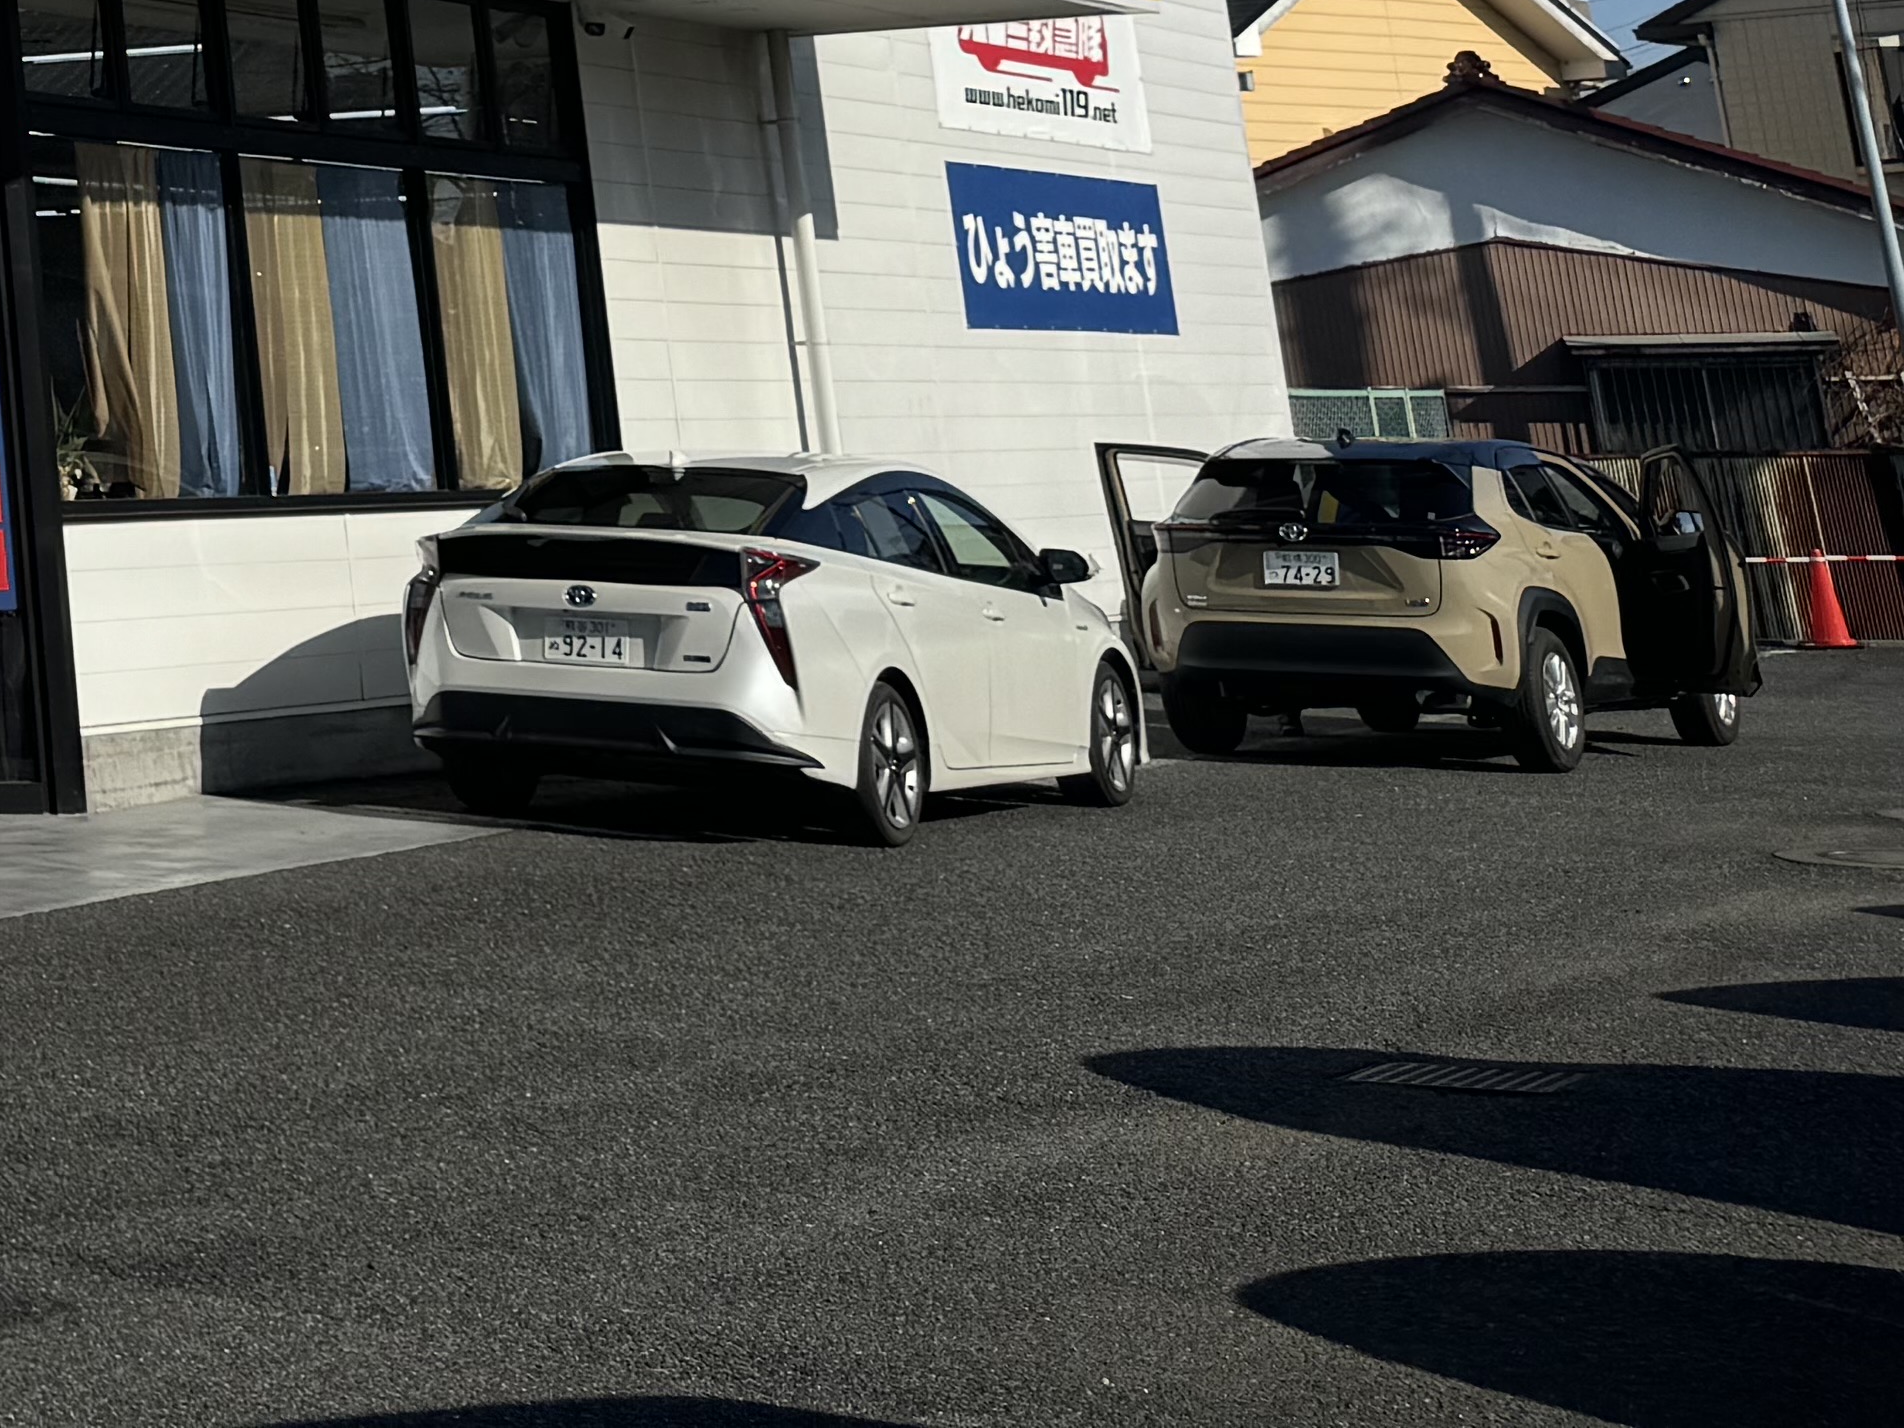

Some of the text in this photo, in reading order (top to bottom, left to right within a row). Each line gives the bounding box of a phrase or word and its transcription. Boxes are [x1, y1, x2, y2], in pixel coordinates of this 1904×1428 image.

[964, 85, 1119, 124] www.hekomi119.net
[1280, 565, 1336, 585] 74-29
[562, 633, 623, 660] 92-14
